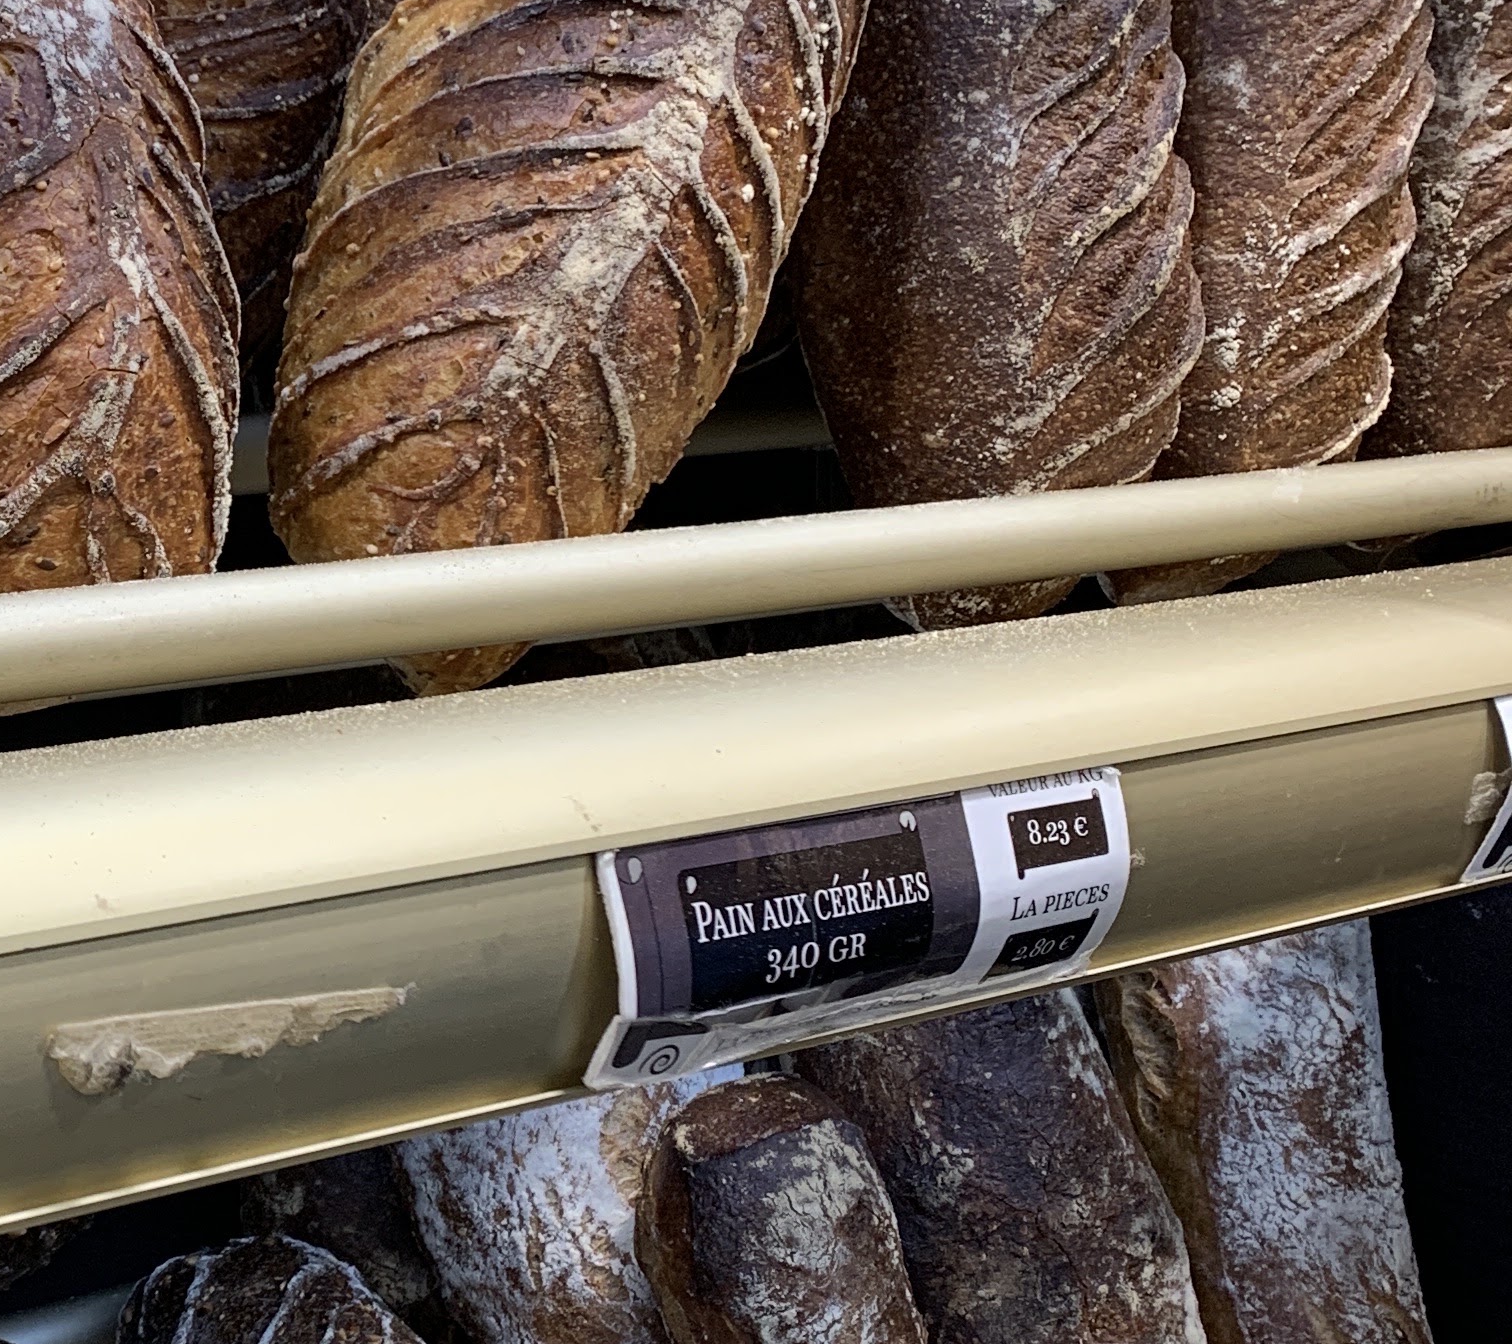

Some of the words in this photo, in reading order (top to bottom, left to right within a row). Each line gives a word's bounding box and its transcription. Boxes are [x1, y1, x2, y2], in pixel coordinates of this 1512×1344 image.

[988, 776, 1050, 798] VALEUR
[1027, 819, 1071, 846] 8.23
[1073, 816, 1089, 837] €
[691, 900, 757, 943] PAIN
[761, 892, 812, 932] AUX
[813, 867, 931, 921] CÉRÉALES
[1009, 896, 1037, 922] LA
[1042, 883, 1110, 915] PIECES
[765, 941, 820, 984] 340
[828, 932, 867, 963] GR
[1011, 937, 1055, 962] 2.80
[1058, 934, 1075, 951] €
